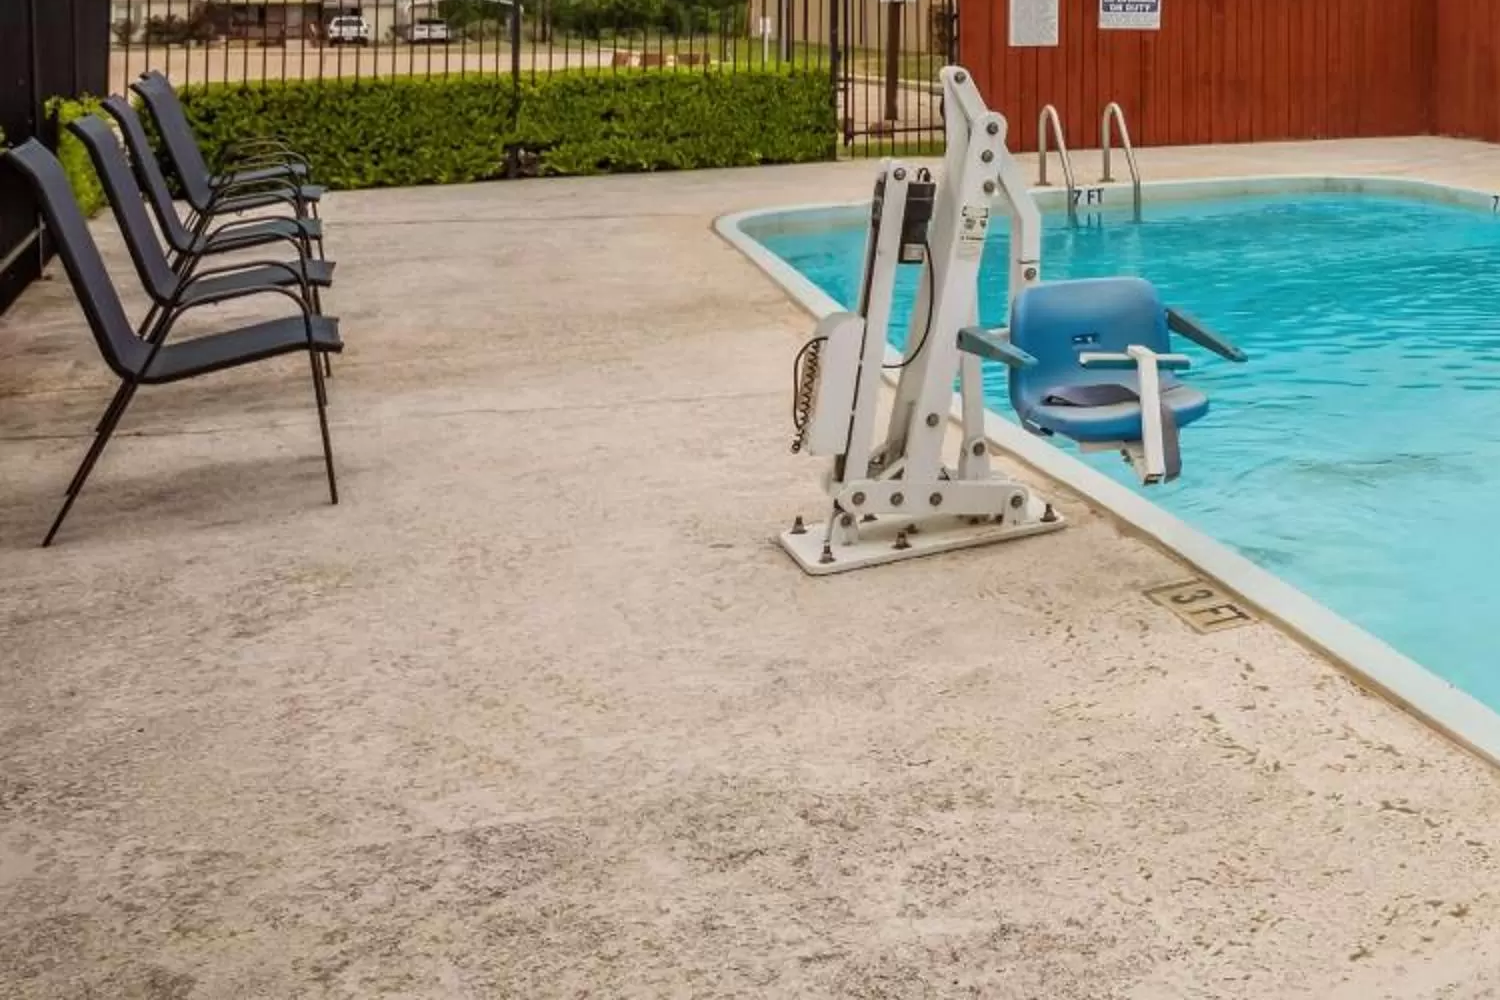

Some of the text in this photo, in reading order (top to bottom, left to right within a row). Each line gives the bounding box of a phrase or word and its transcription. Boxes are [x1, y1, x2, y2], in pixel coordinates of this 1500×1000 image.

[1073, 187, 1104, 204] 7 FT
[1188, 603, 1251, 627] FT
